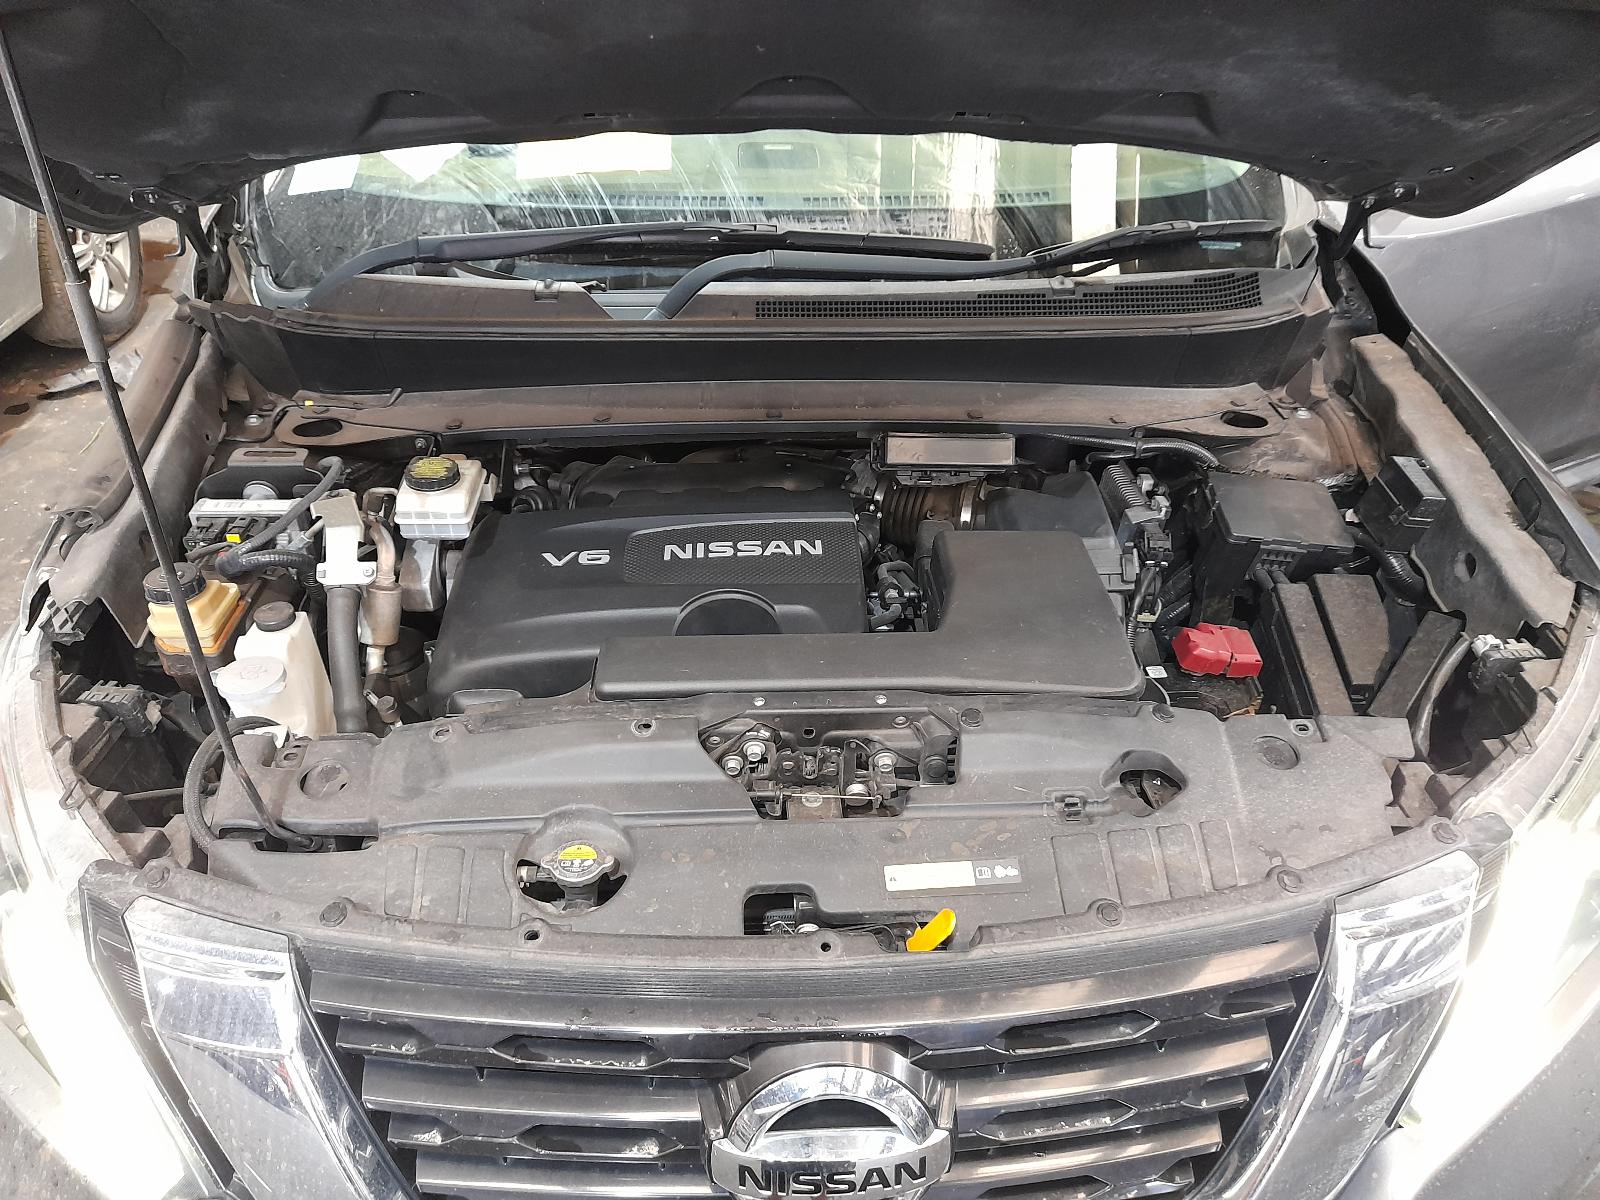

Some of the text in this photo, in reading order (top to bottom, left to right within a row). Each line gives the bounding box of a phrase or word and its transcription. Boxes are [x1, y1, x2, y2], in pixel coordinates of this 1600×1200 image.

[541, 549, 611, 567] V6
[663, 539, 823, 561] NISSAN
[738, 1156, 928, 1196] NISSAN
